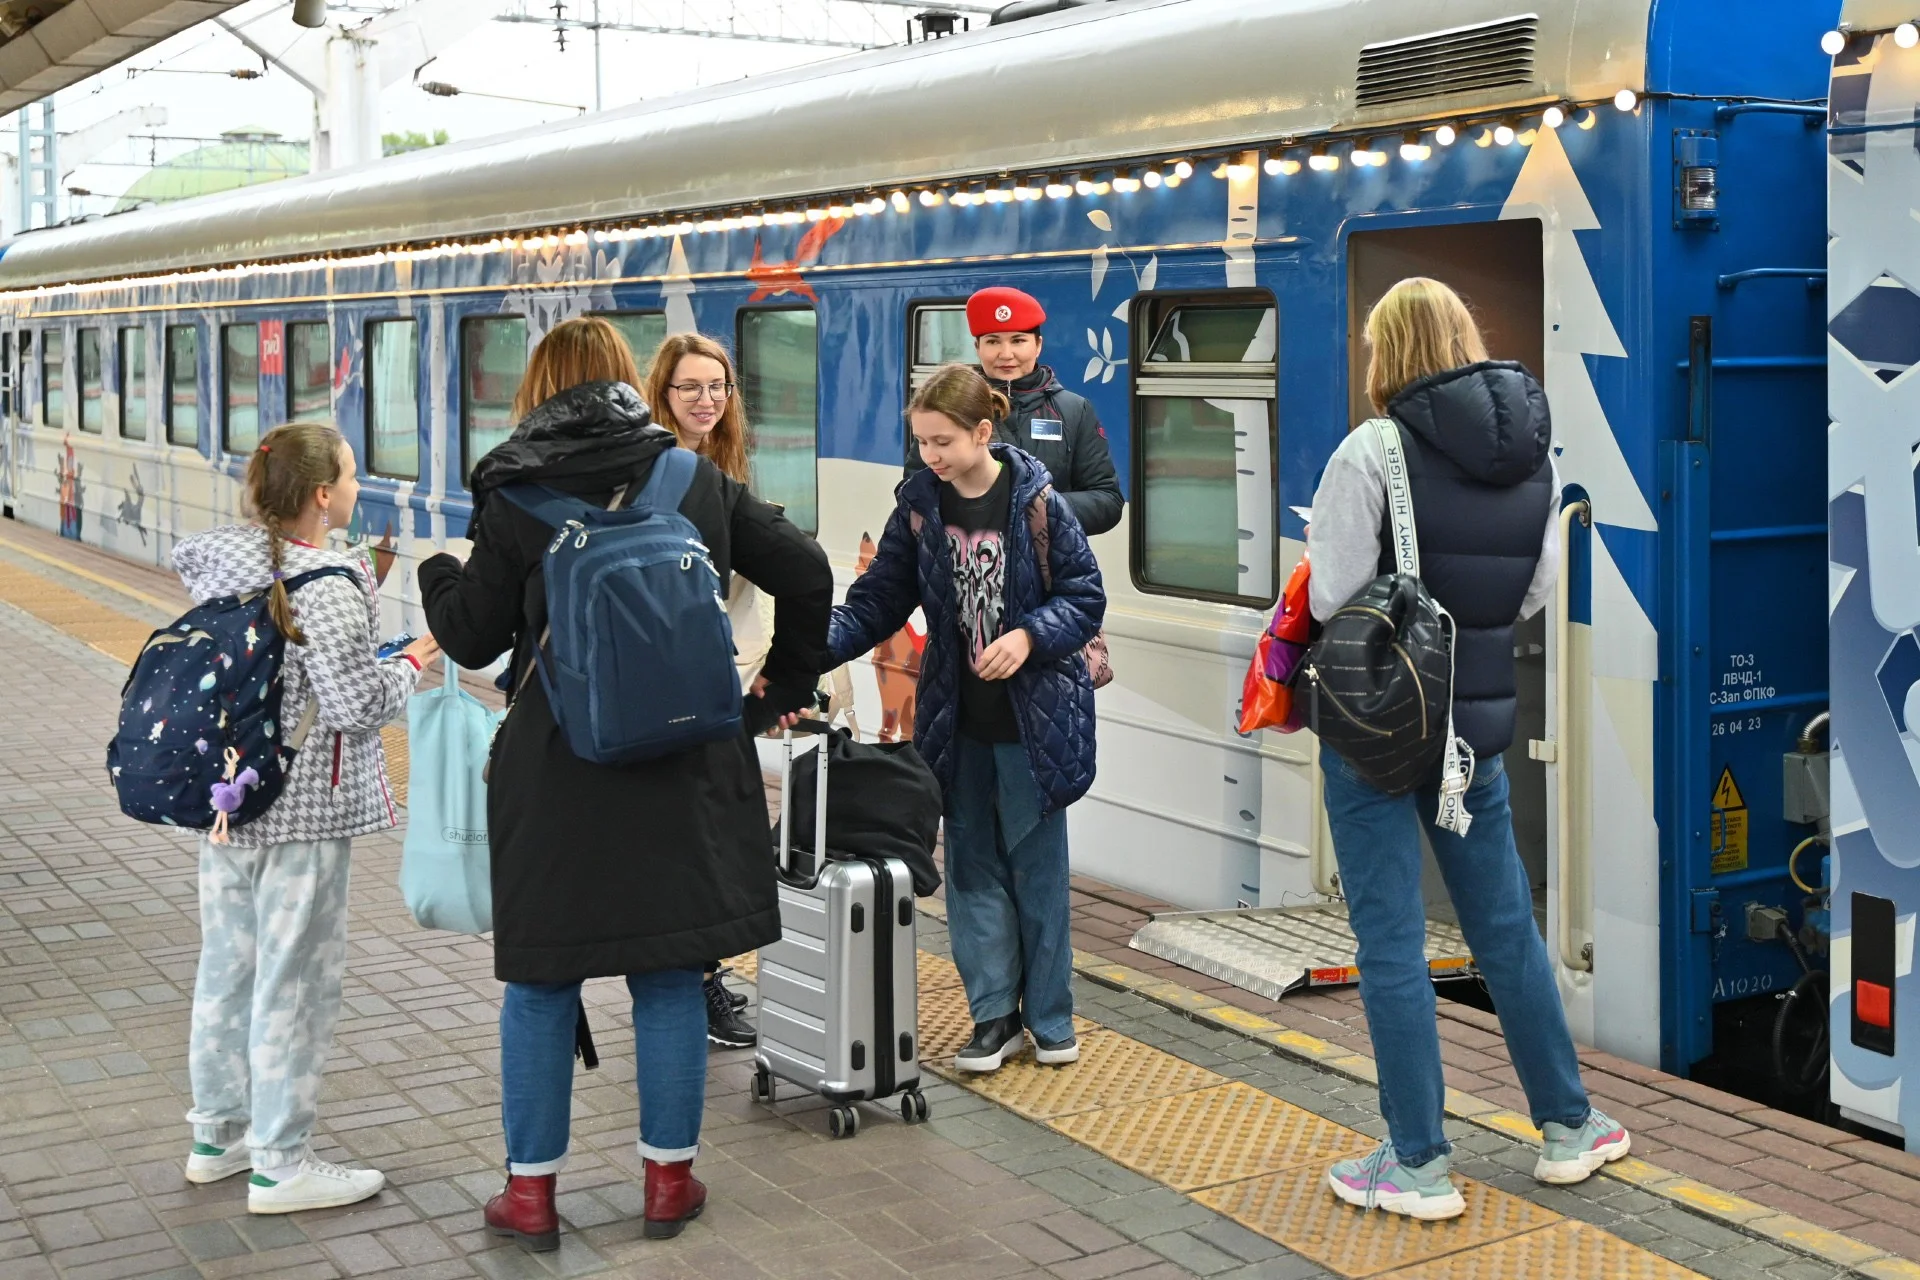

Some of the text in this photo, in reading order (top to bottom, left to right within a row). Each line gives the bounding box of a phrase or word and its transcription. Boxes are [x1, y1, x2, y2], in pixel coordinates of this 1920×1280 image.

[1387, 446, 1408, 515] HILFIGER
[1730, 654, 1754, 668] ТО-3
[1722, 670, 1762, 686] ЛВЧД-1
[1709, 686, 1776, 705] С-Зап ФПКФ
[1712, 716, 1761, 736] 26 04 23
